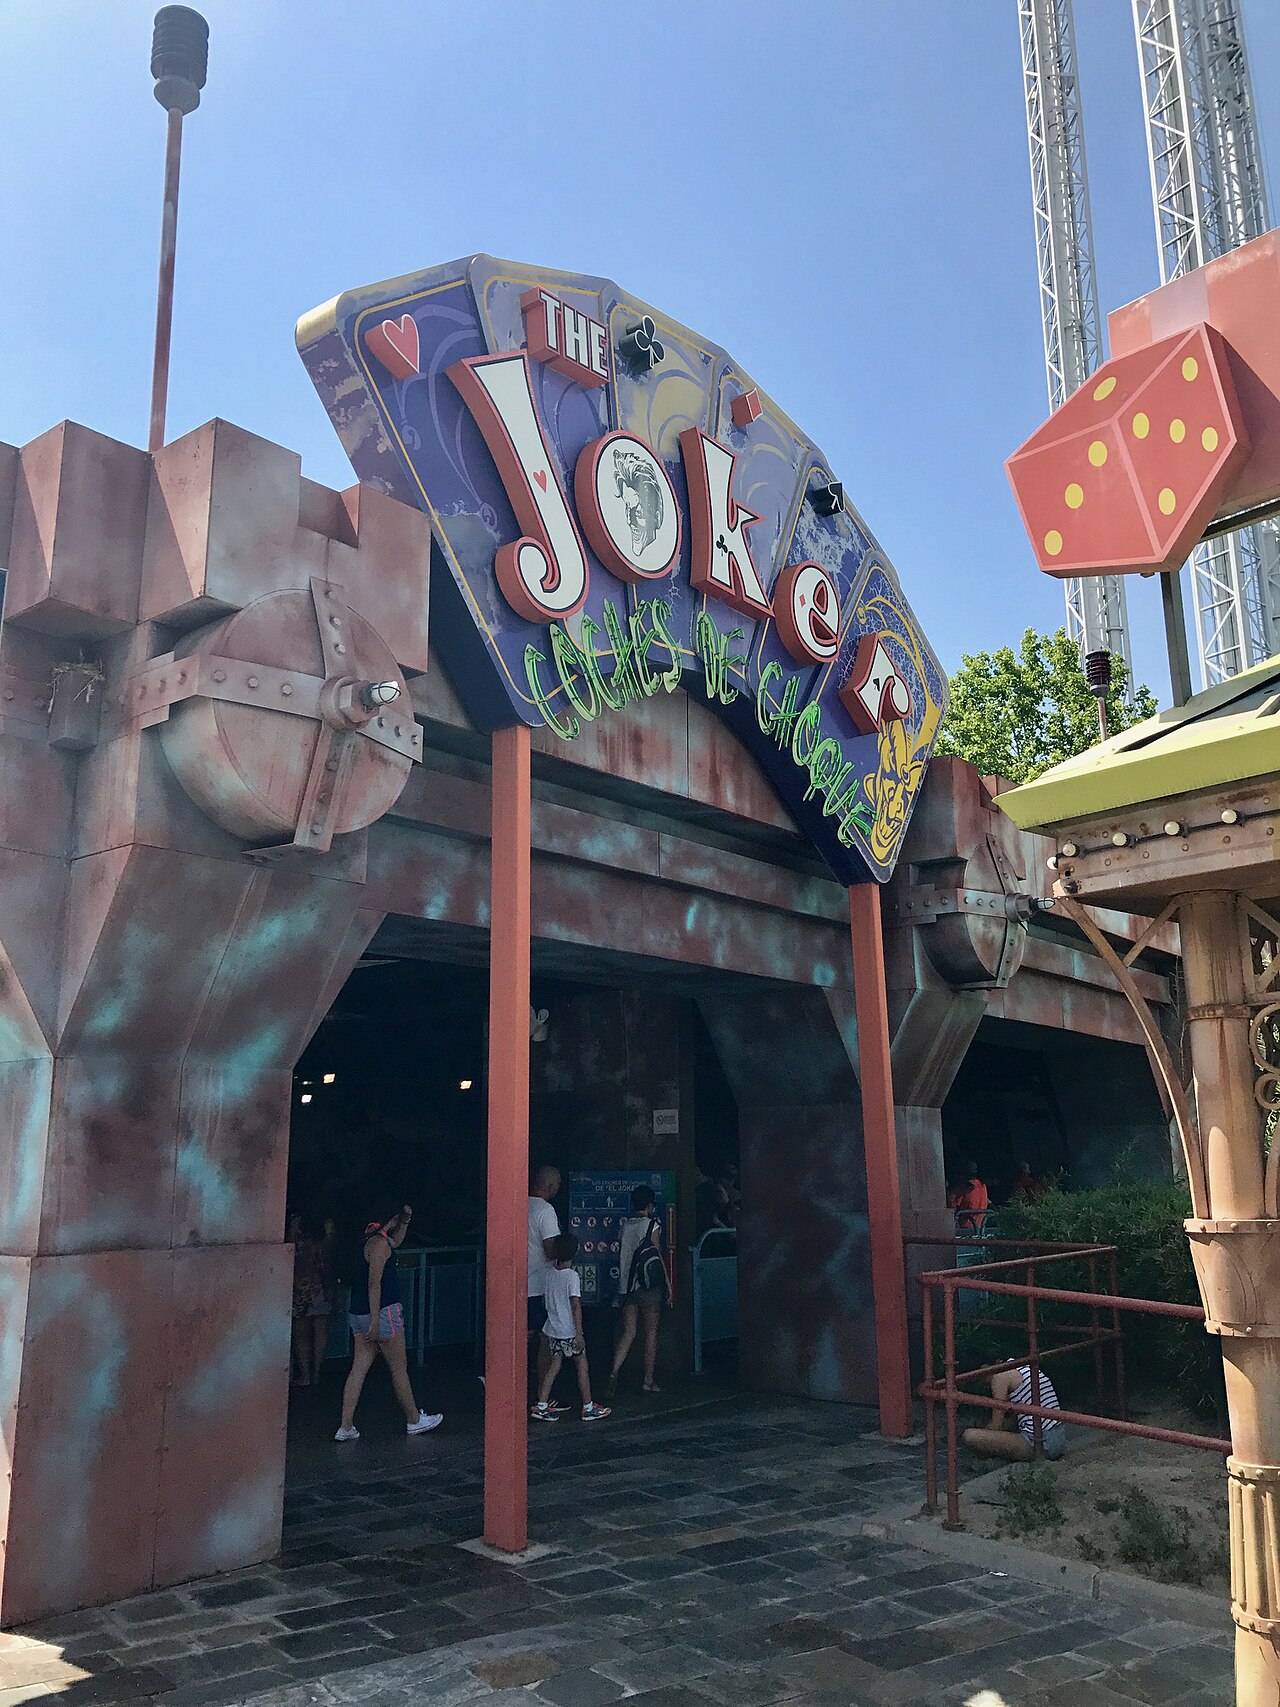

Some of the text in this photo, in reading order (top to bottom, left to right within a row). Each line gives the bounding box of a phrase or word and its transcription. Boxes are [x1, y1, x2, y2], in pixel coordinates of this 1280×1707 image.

[538, 287, 610, 382] THE
[524, 598, 880, 848] COCHES DE CHOQUE
